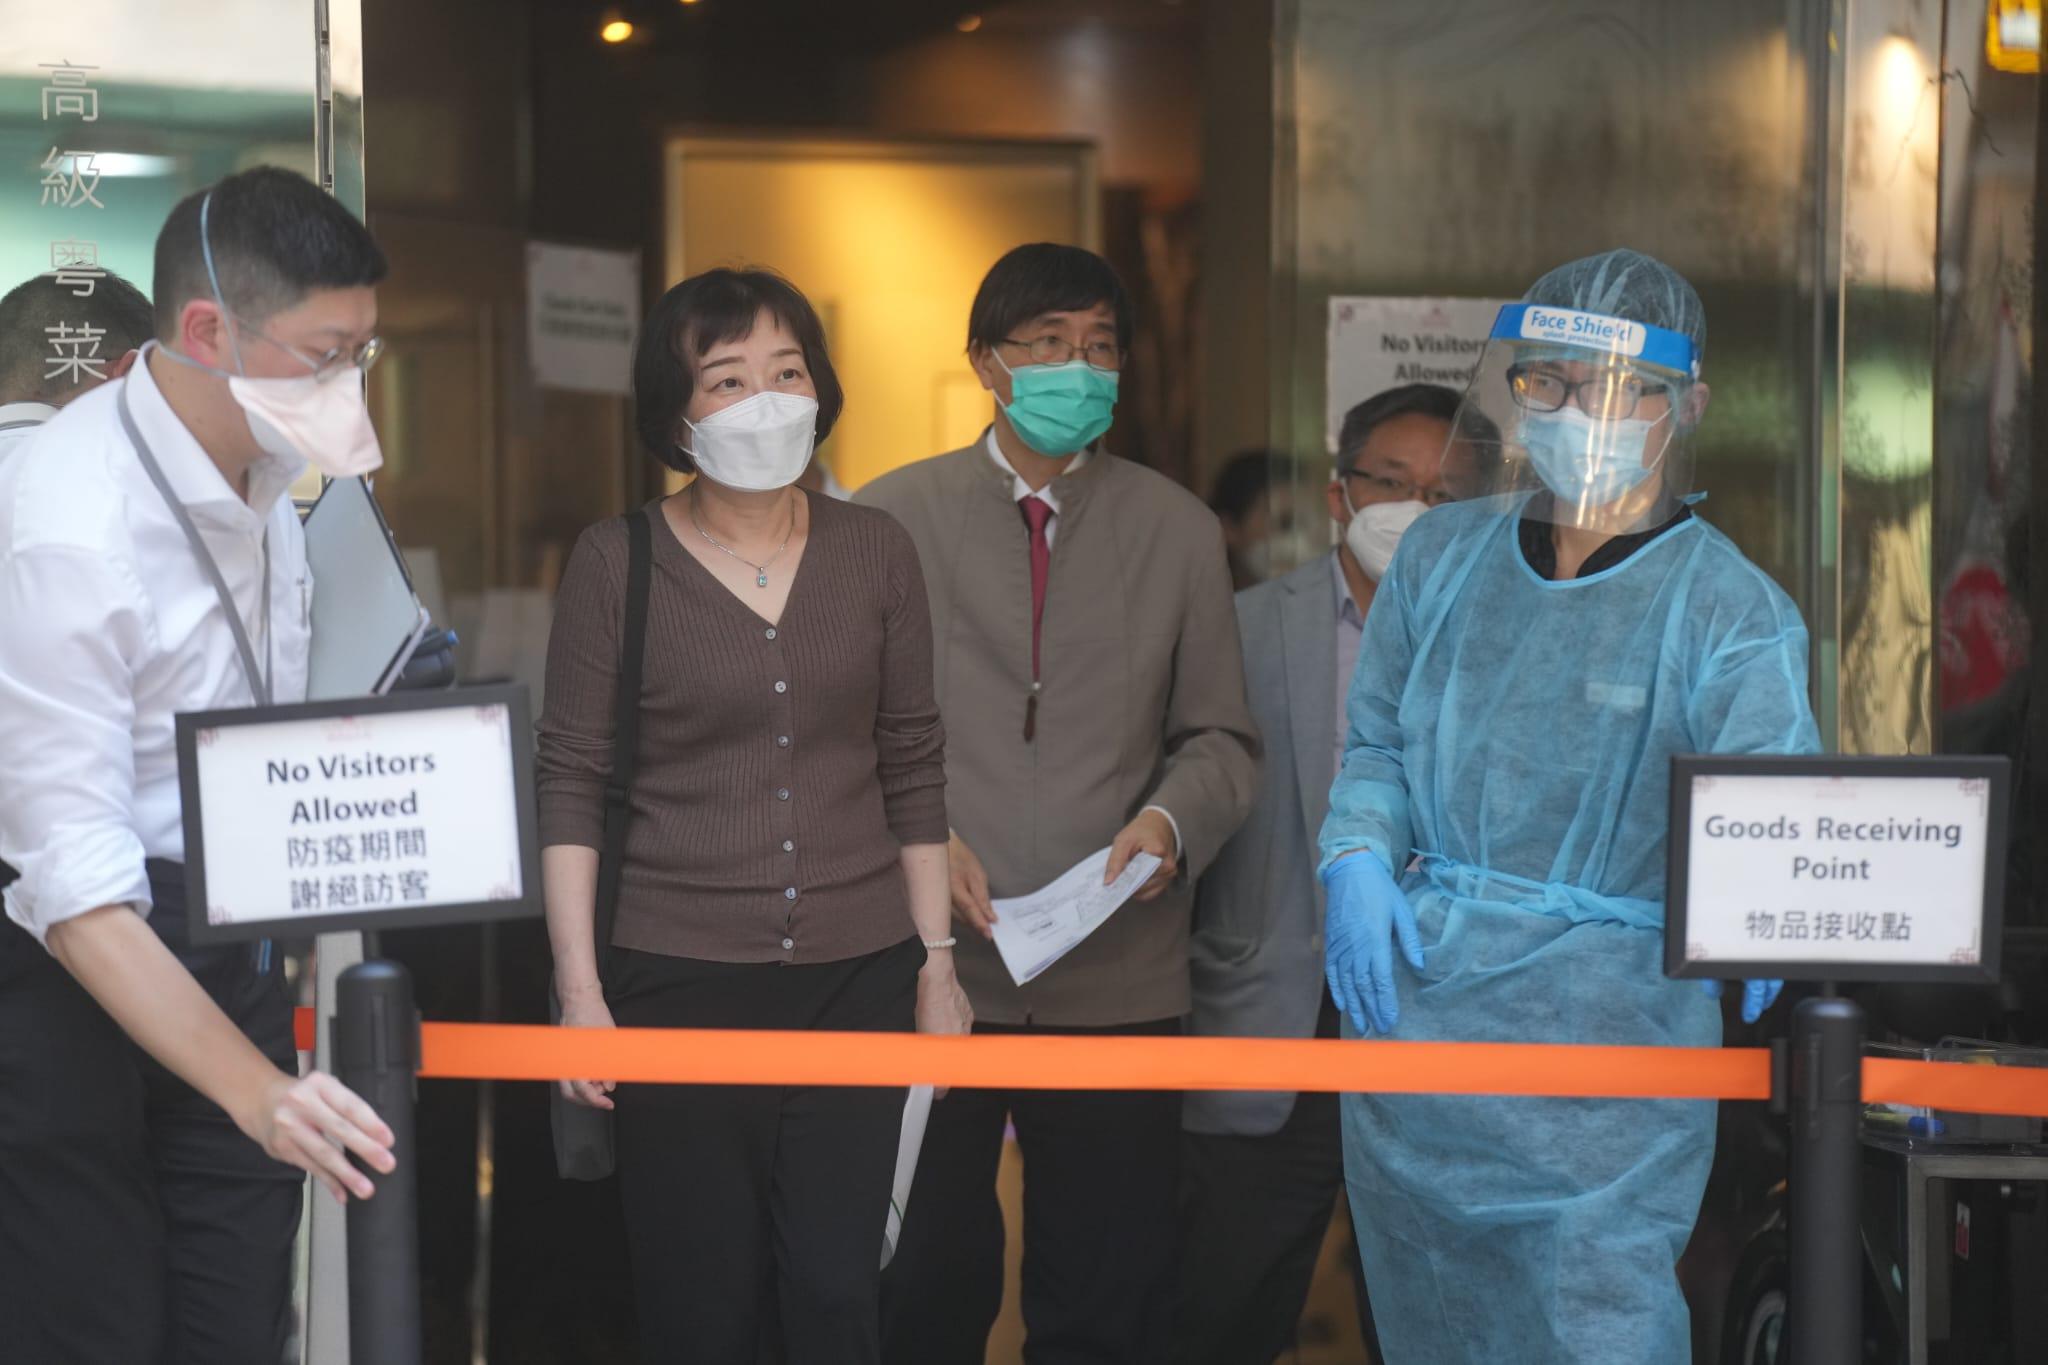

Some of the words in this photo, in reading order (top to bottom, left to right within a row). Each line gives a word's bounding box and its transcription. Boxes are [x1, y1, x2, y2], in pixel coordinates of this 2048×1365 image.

[1531, 310, 1567, 330] Face
[1382, 333, 1410, 352] No
[1414, 334, 1488, 353] Visitor
[266, 759, 310, 784] No
[318, 751, 436, 780] Visitors
[291, 789, 418, 825] Allowed
[286, 827, 428, 869] 防疫期間
[1704, 815, 1800, 840] Goods
[1816, 816, 1962, 848] Receiving
[1792, 856, 1871, 880] Point
[290, 869, 429, 910] 謝絕訪客
[1745, 910, 1912, 941] 物品接收點
